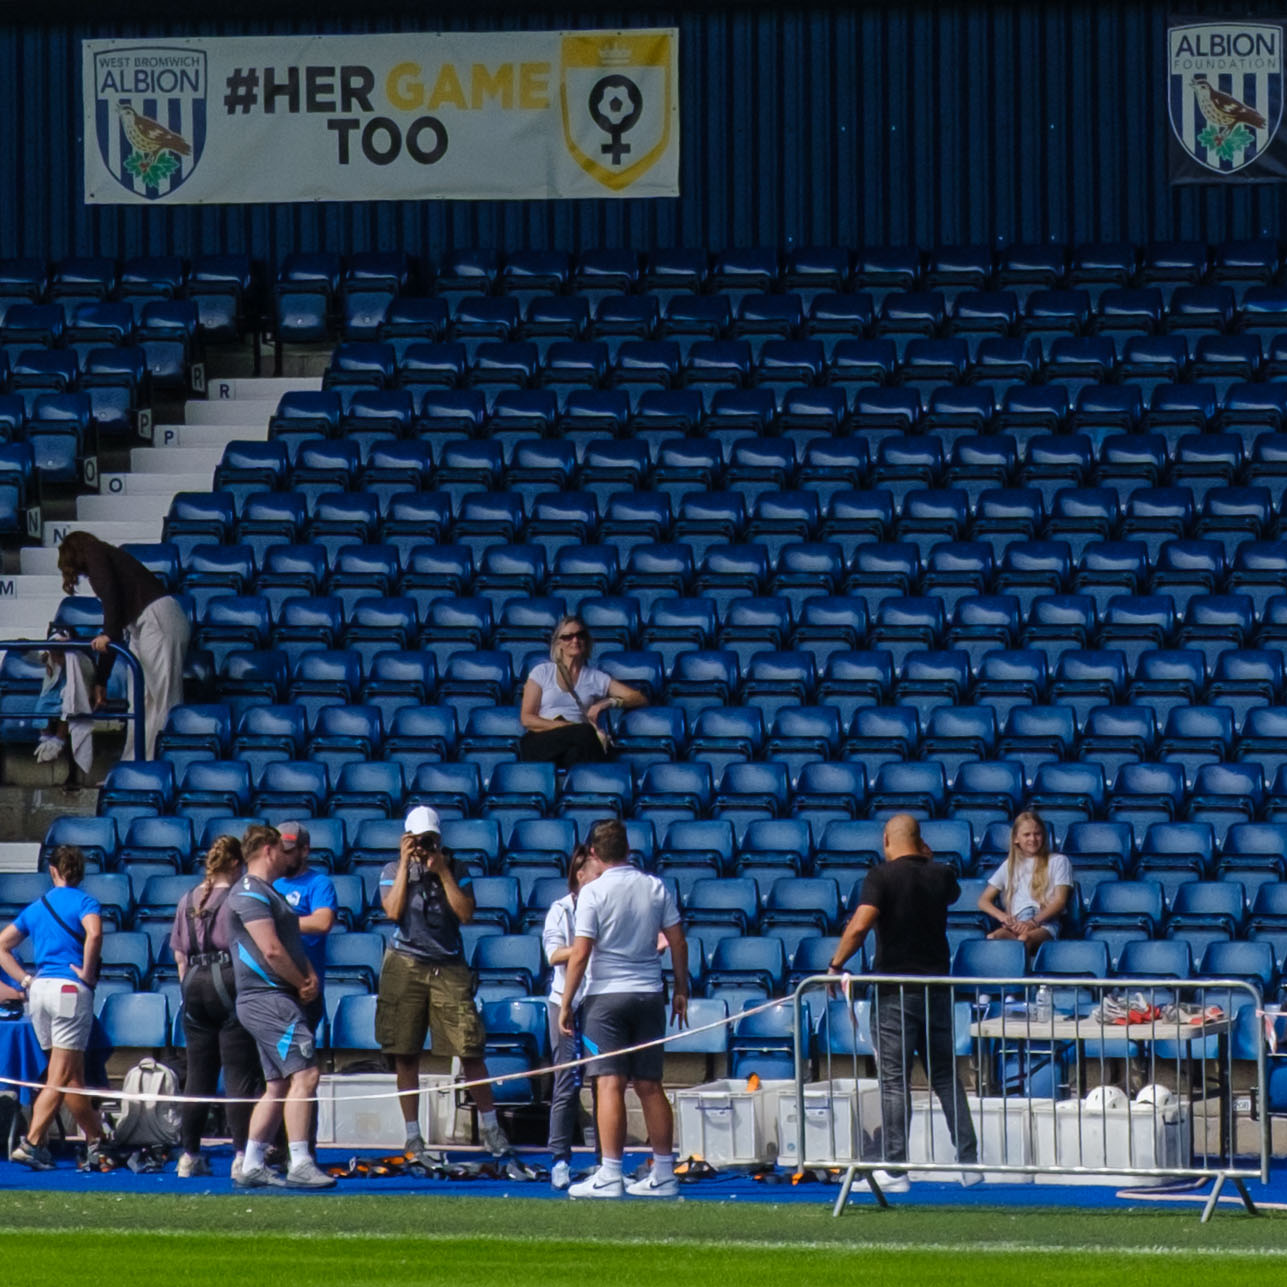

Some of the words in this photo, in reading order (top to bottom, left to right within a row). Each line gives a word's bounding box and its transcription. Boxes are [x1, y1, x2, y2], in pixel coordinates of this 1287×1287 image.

[1175, 33, 1275, 57] ALBION
[99, 57, 131, 67] WEST
[134, 56, 200, 67] BROMWICH
[1174, 58, 1276, 70] FOUNDATION
[100, 69, 199, 93] ALBION
[223, 66, 374, 115] #HER
[385, 62, 551, 111] GAME
[328, 116, 448, 165] TOO
[219, 385, 230, 399] R
[140, 413, 149, 434] P
[164, 431, 174, 445] P
[109, 479, 123, 493] O
[28, 511, 39, 533] N
[53, 528, 66, 543] N
[0, 581, 14, 595] M
